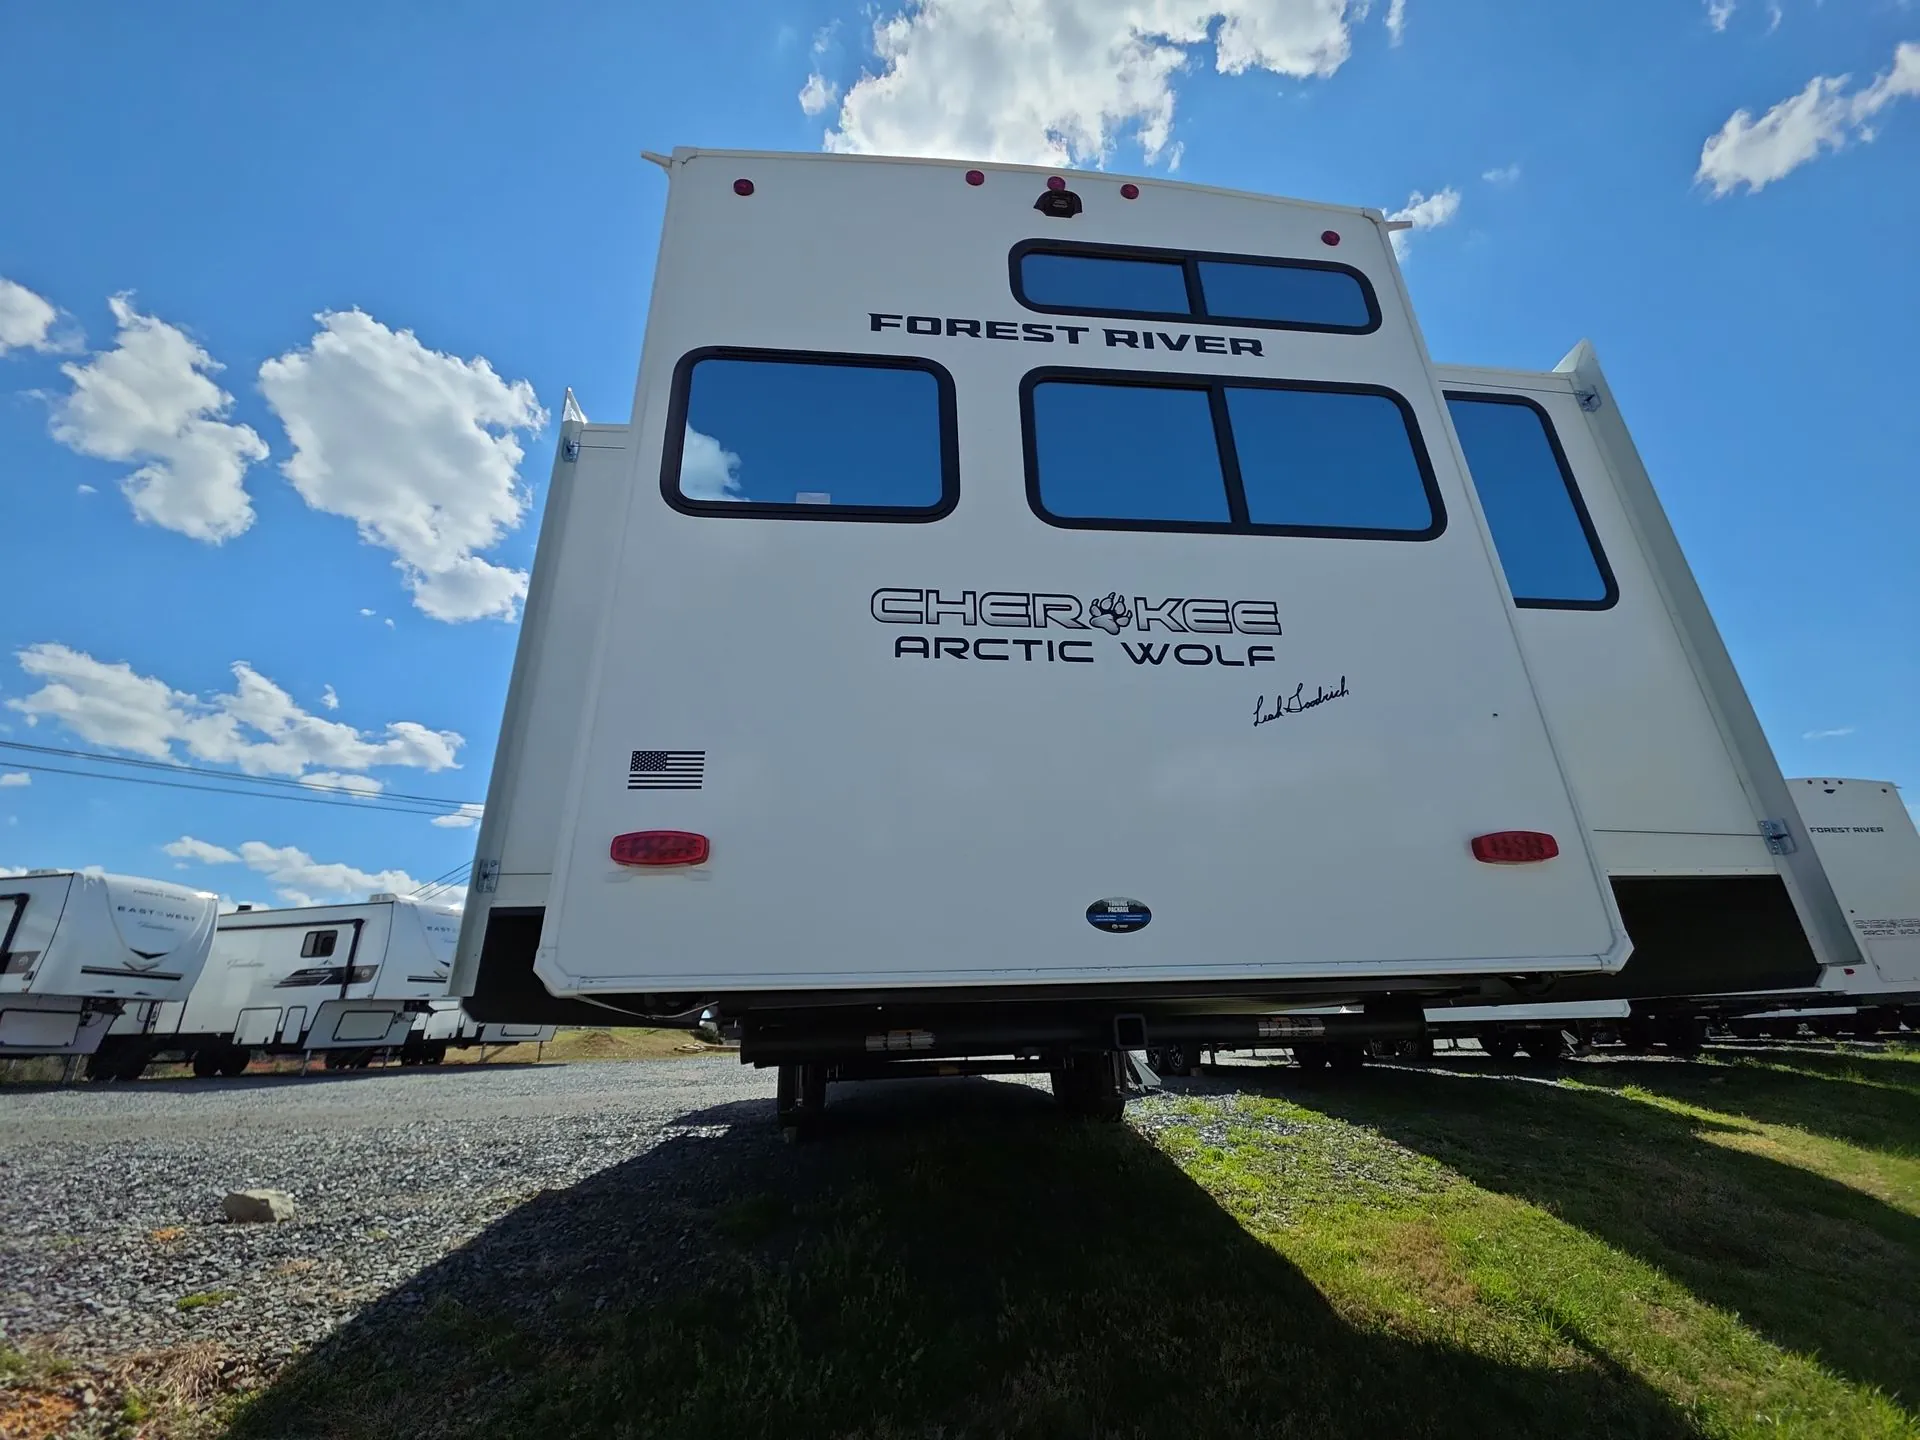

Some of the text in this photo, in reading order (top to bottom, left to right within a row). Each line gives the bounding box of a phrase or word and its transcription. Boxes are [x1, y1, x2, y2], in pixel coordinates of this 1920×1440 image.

[868, 313, 1265, 357] FOREST RIVER
[870, 587, 1282, 636] CHEROKEE
[894, 636, 1276, 667] ARCTIC WOLF
[1253, 695, 1285, 727] Leah
[117, 905, 154, 916] EAST
[165, 911, 196, 922] WEST
